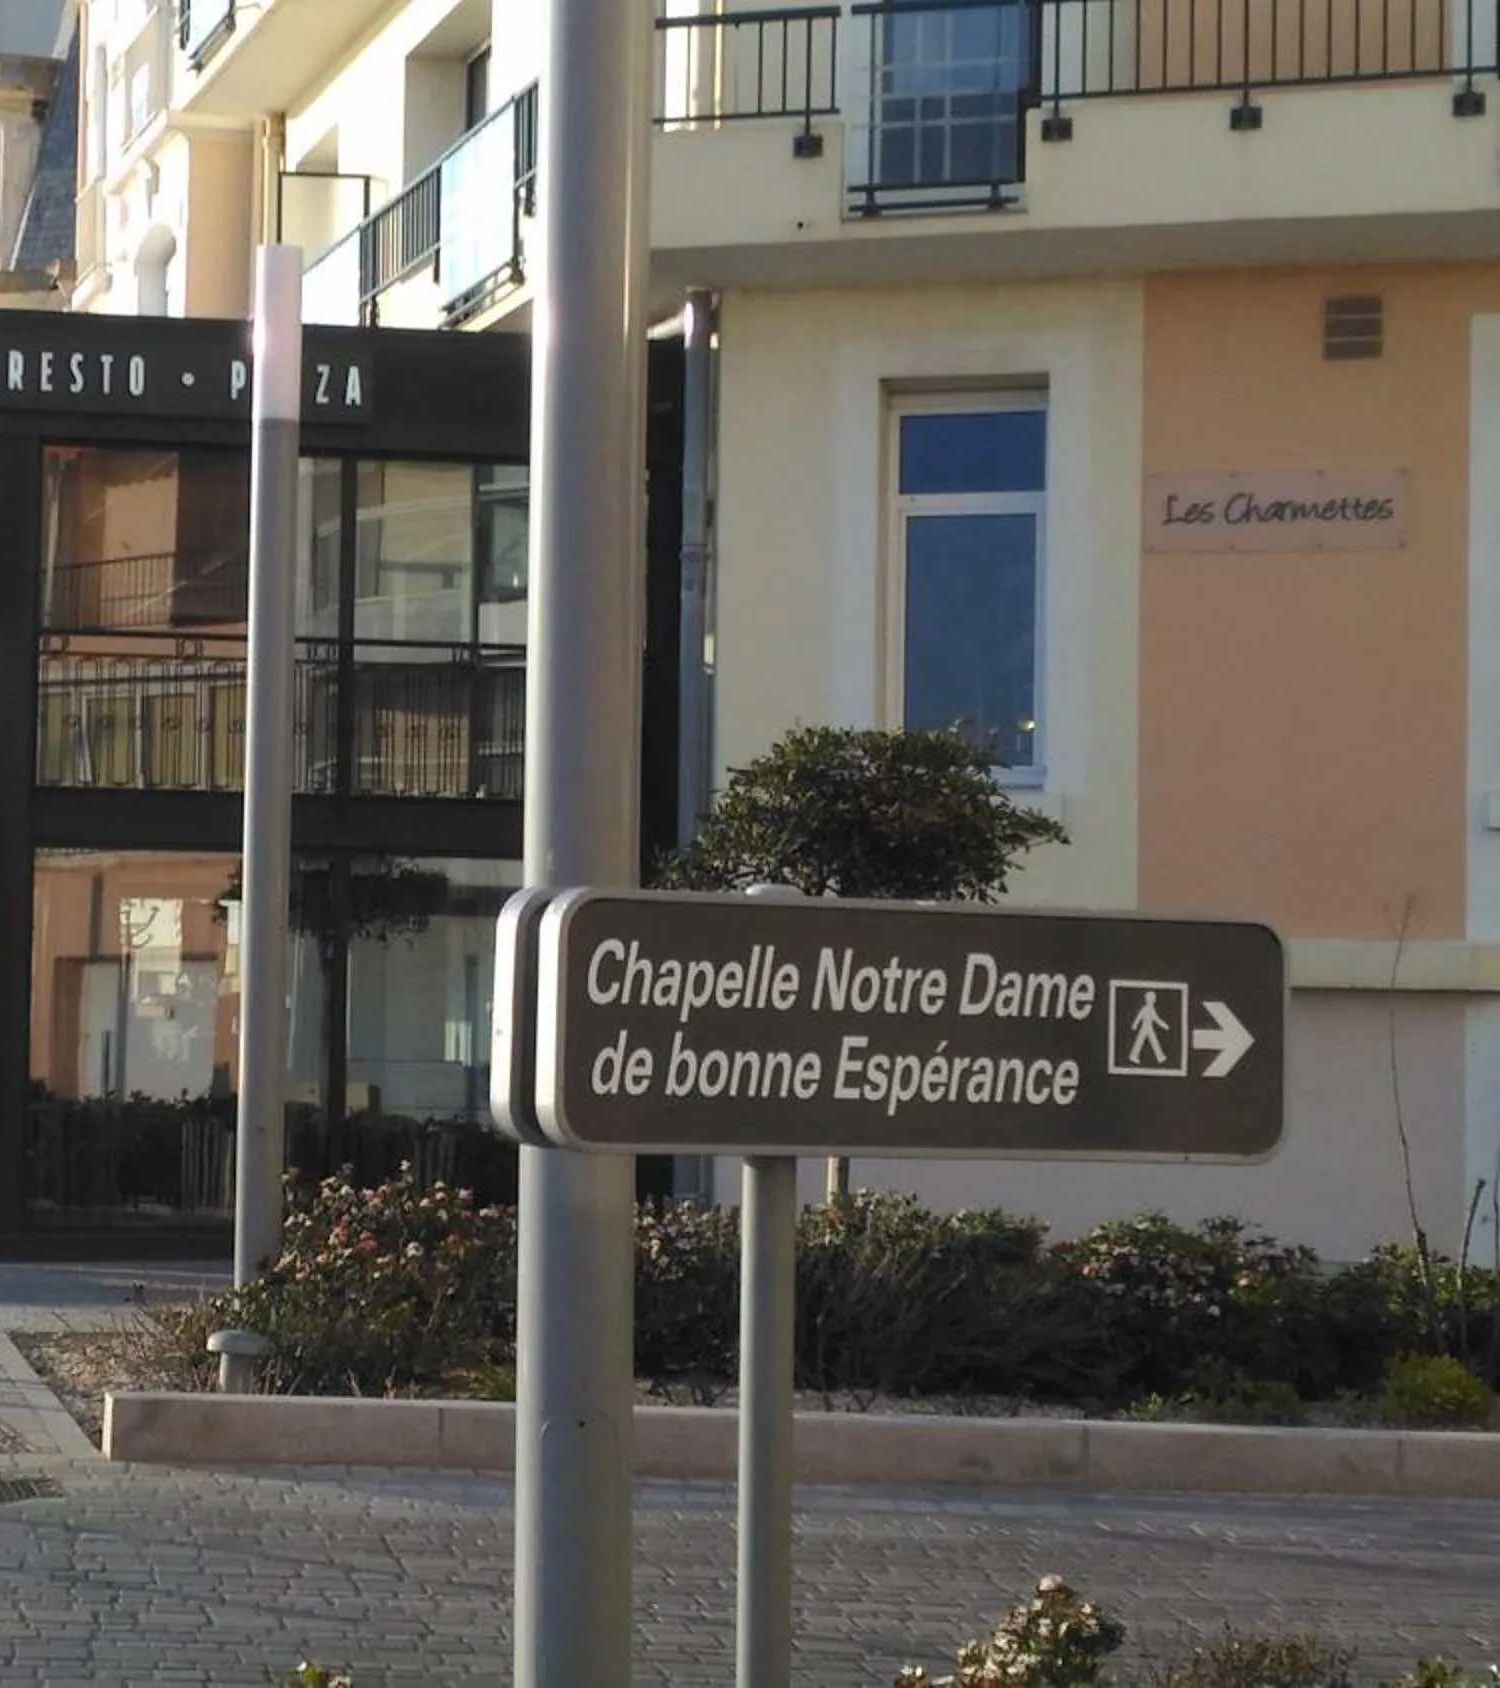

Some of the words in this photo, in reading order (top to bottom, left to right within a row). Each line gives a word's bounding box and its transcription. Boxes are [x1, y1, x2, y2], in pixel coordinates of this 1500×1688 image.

[7, 349, 146, 397] RESTO
[230, 359, 362, 406] PZA
[1161, 493, 1216, 526] Les
[1222, 491, 1395, 526] Charmettes
[587, 938, 800, 1024] Chapelle
[811, 946, 948, 1016] Notre
[958, 952, 1096, 1020] Dame
[591, 1028, 653, 1097] de
[664, 1030, 822, 1101] bonne
[833, 1035, 1080, 1117] Espérance
